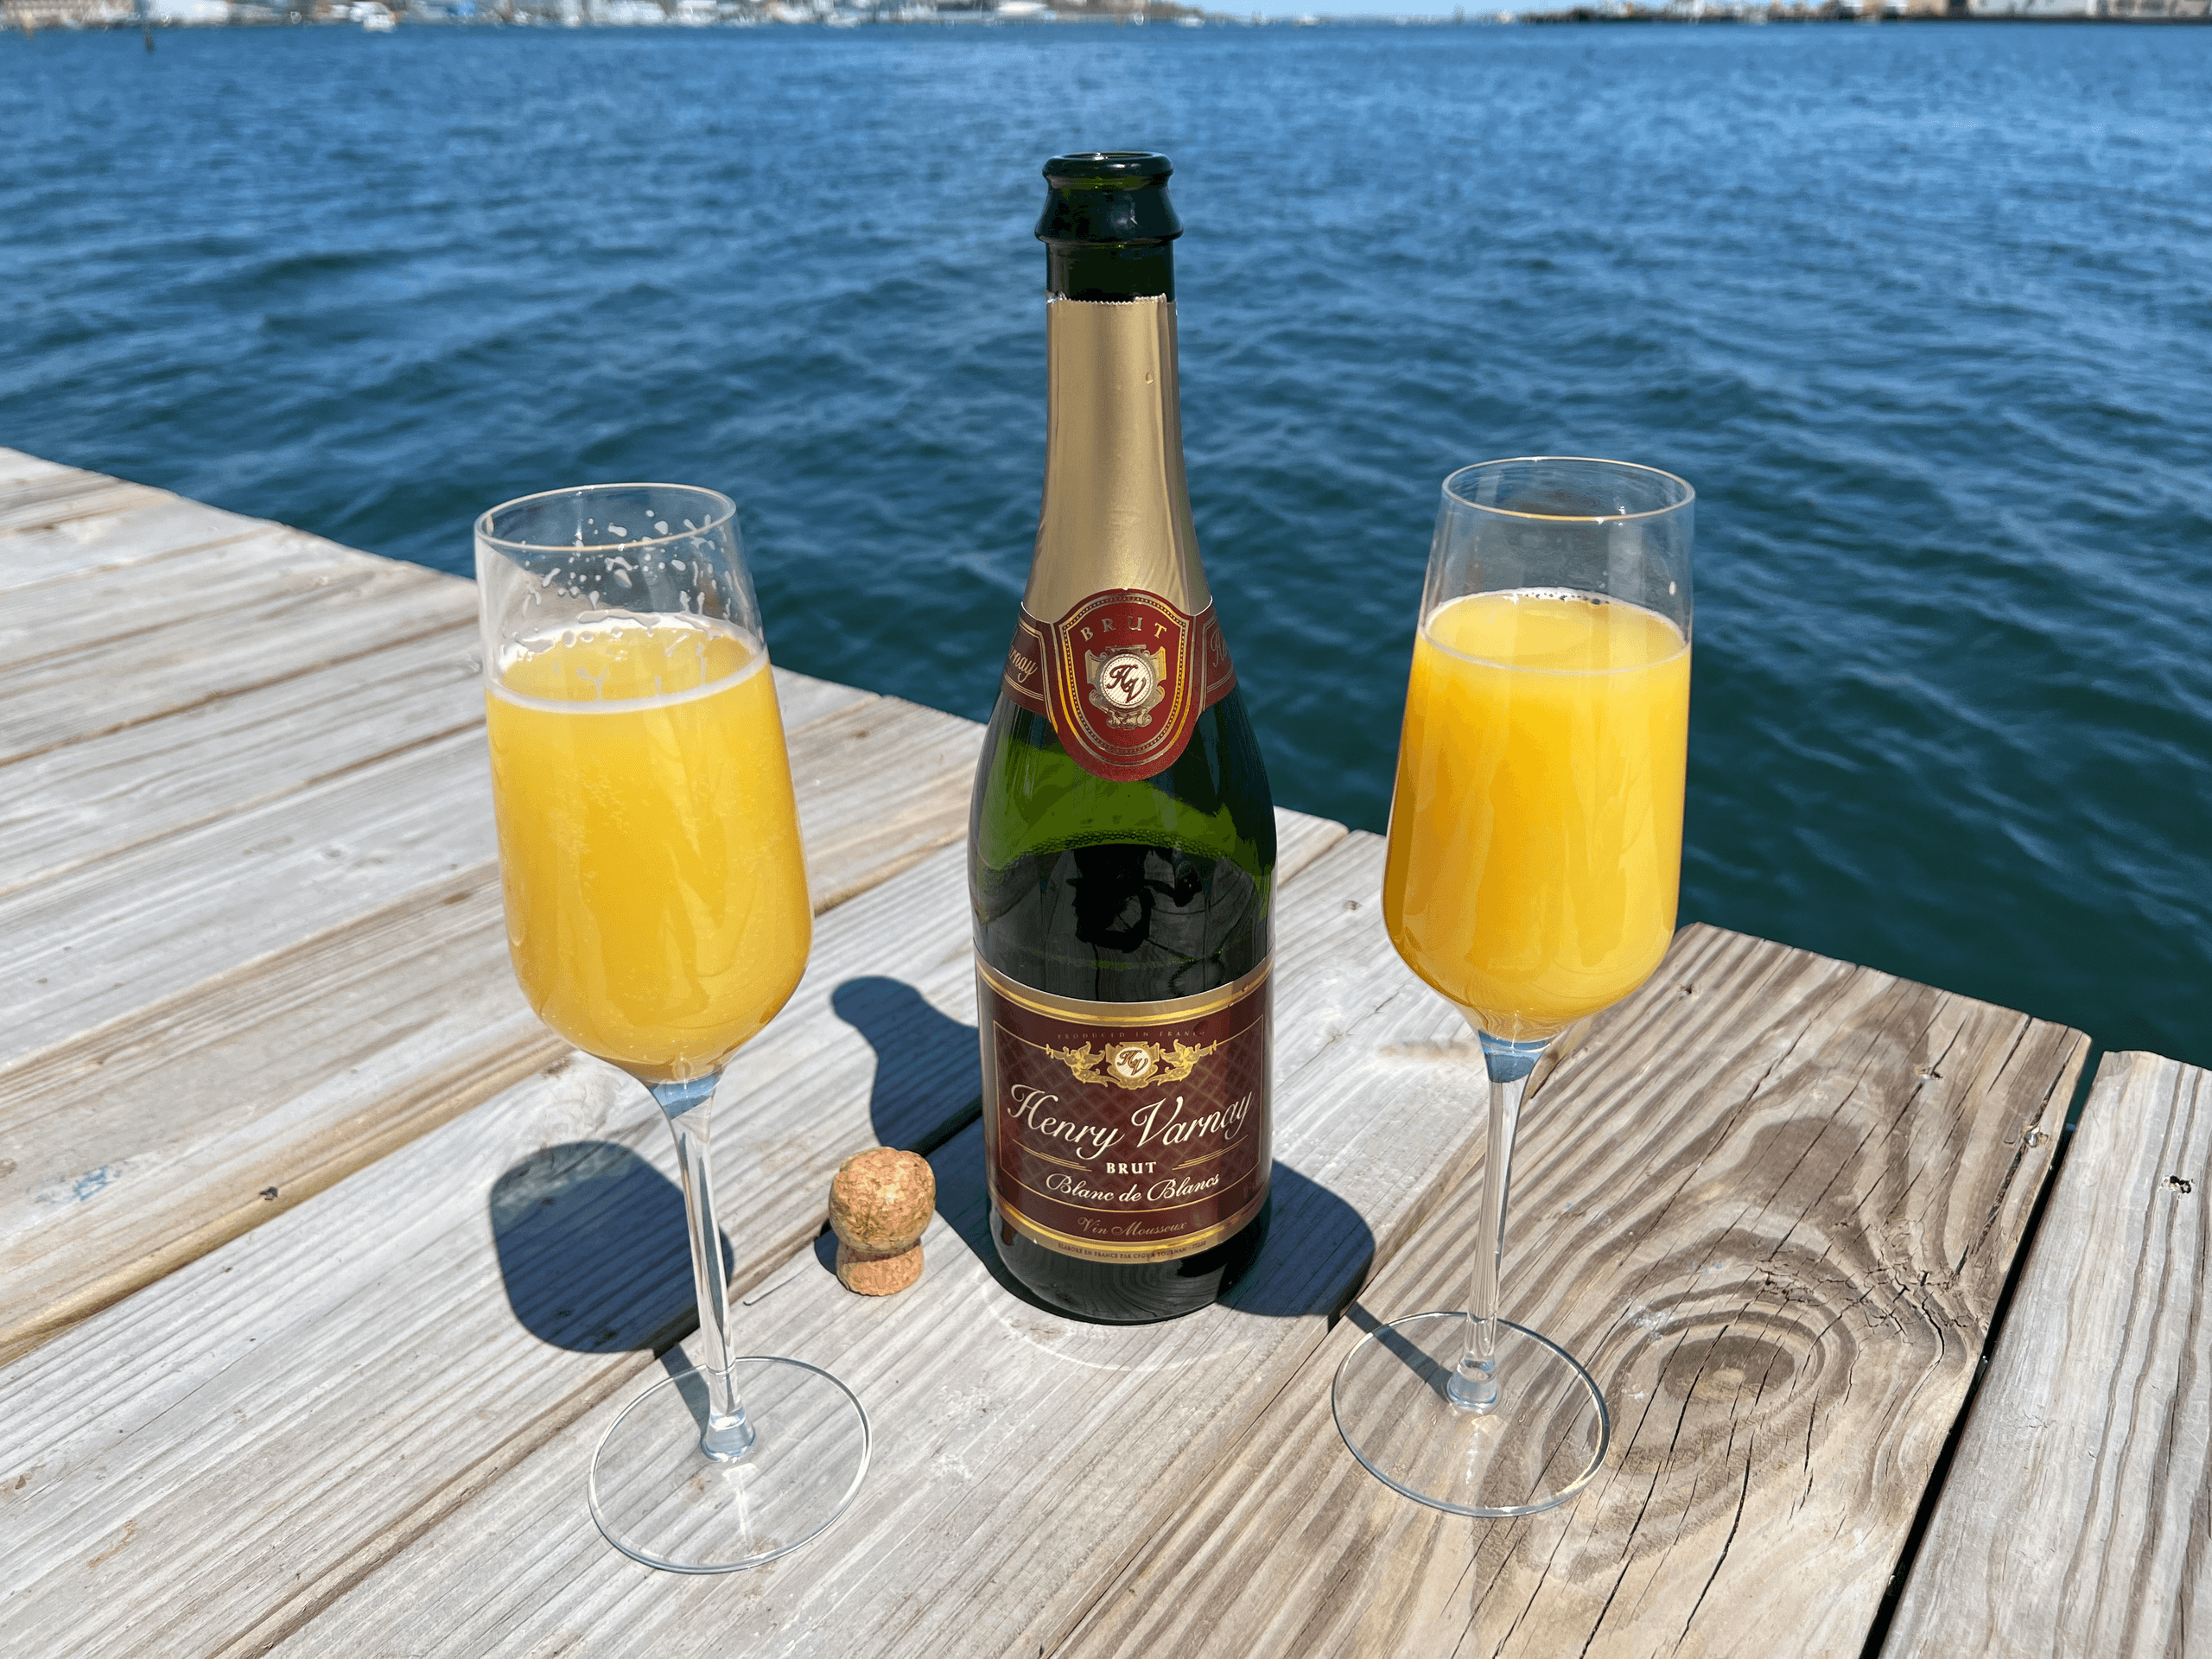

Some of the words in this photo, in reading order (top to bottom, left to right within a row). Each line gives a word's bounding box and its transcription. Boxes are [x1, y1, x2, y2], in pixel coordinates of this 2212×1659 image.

[1081, 615, 1167, 642] BRUT
[1007, 1084, 1125, 1160] Henry
[1131, 1090, 1253, 1147] Varnay
[1106, 1161, 1157, 1174] BRUT
[1046, 1173, 1115, 1202] Blanc
[1118, 1184, 1142, 1202] de
[1147, 1173, 1220, 1202] Blancs
[1077, 1217, 1108, 1235] Vin
[1111, 1221, 1187, 1236] Mousseux
